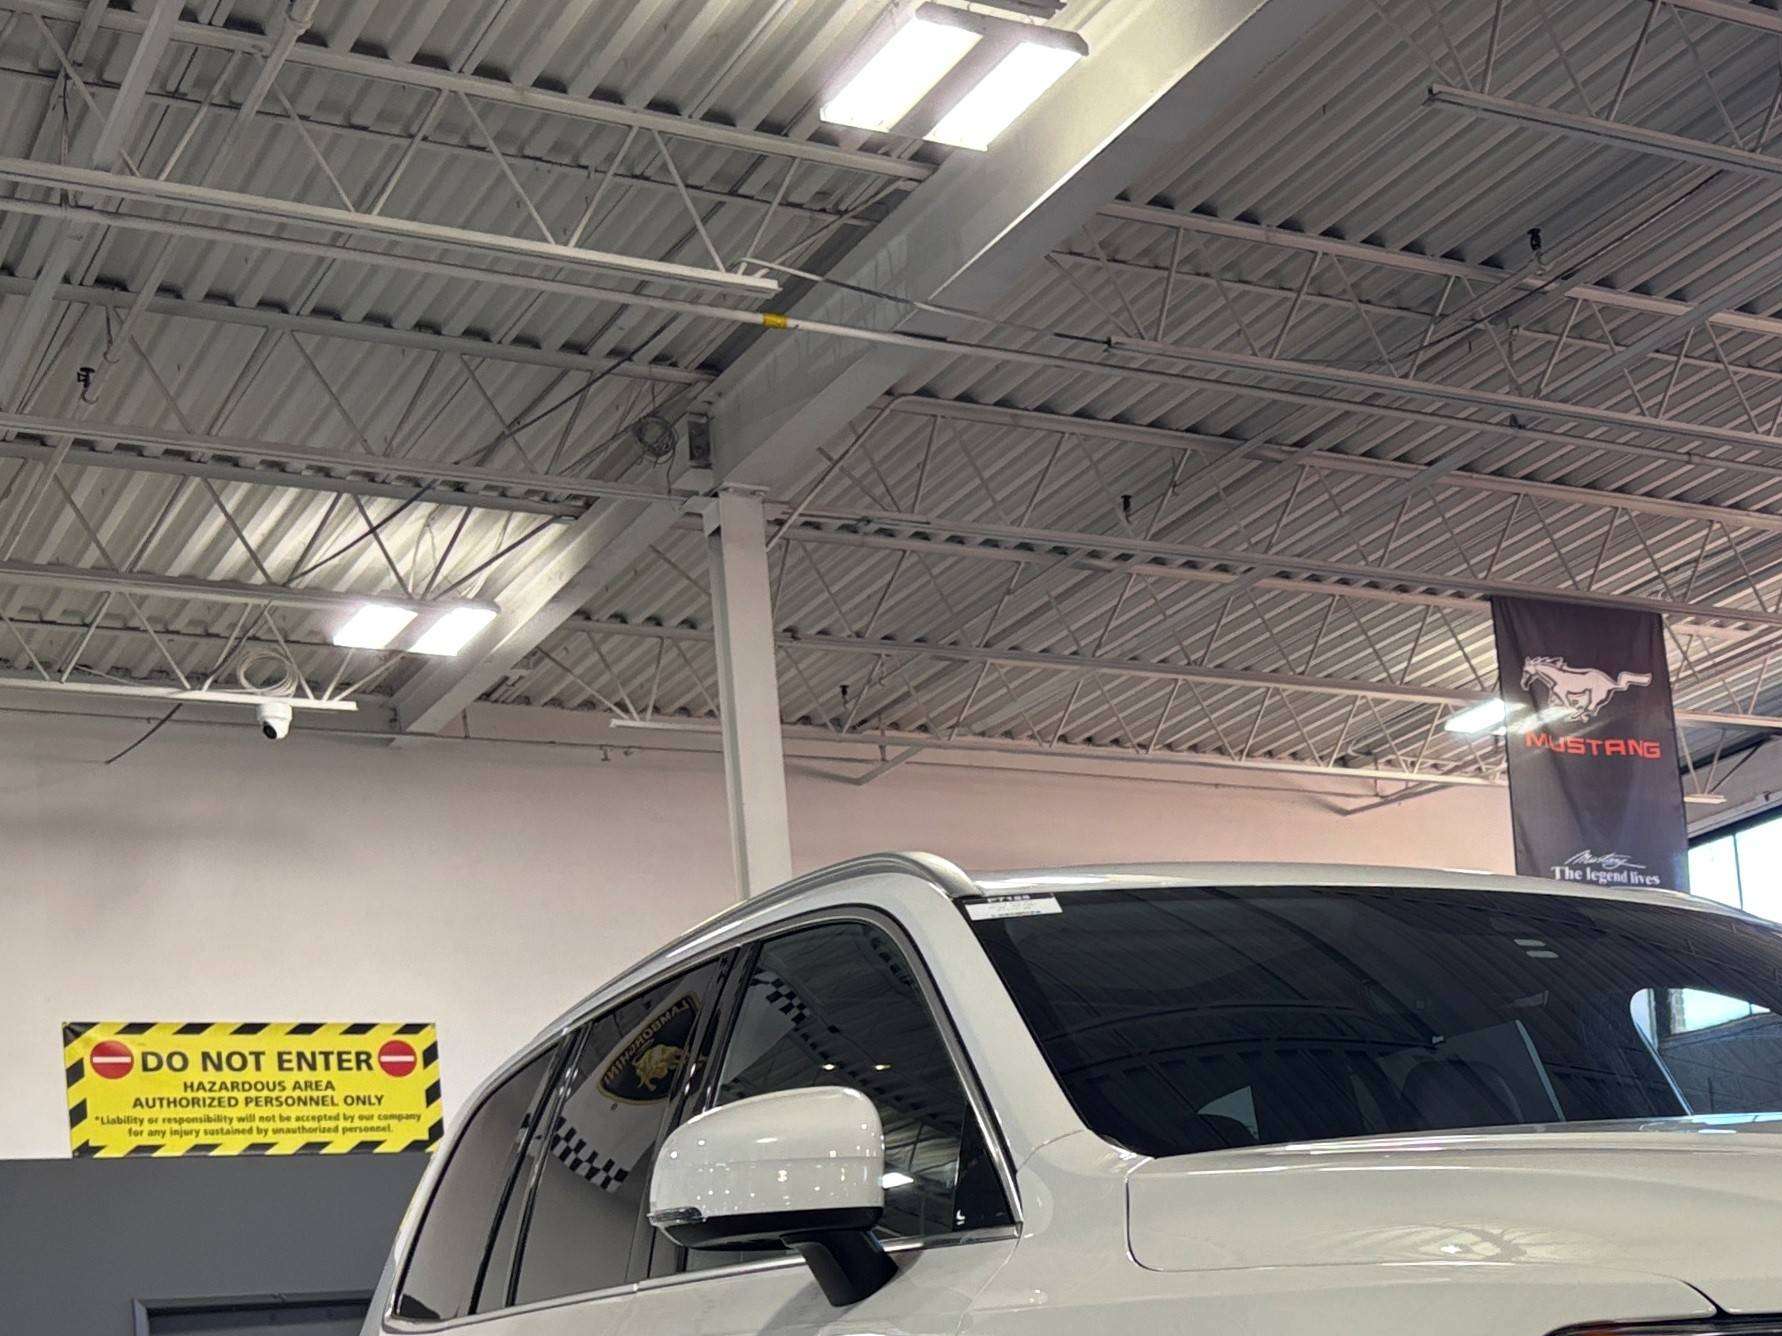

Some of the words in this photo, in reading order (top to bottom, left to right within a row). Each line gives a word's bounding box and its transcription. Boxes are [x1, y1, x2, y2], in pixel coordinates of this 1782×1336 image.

[1525, 731, 1661, 758] MUSTANG
[1551, 866, 1585, 880] The
[1586, 867, 1628, 884] legend
[1630, 871, 1661, 886] lives
[141, 1051, 189, 1072] DO
[201, 1051, 265, 1072] NOT
[277, 1050, 373, 1071] ENTER
[183, 1081, 286, 1093] HAZARDOUS
[292, 1080, 336, 1092] AREA
[132, 1096, 239, 1109] AUTHORIZED
[244, 1095, 339, 1107] PERSONNEL
[343, 1094, 384, 1106] ONLY
[148, 1117, 158, 1125] or
[162, 1114, 233, 1127] responsibility
[236, 1113, 256, 1123] will
[258, 1113, 276, 1122] not
[279, 1112, 292, 1122] be
[295, 1112, 340, 1123] accepted
[343, 1111, 355, 1123] by
[358, 1113, 374, 1121] our
[377, 1112, 422, 1122] company
[128, 1128, 143, 1138] for
[147, 1129, 167, 1140] any
[170, 1127, 200, 1139] injury
[203, 1126, 253, 1136] sustained
[256, 1125, 269, 1136] by
[272, 1124, 339, 1135] unauthorized
